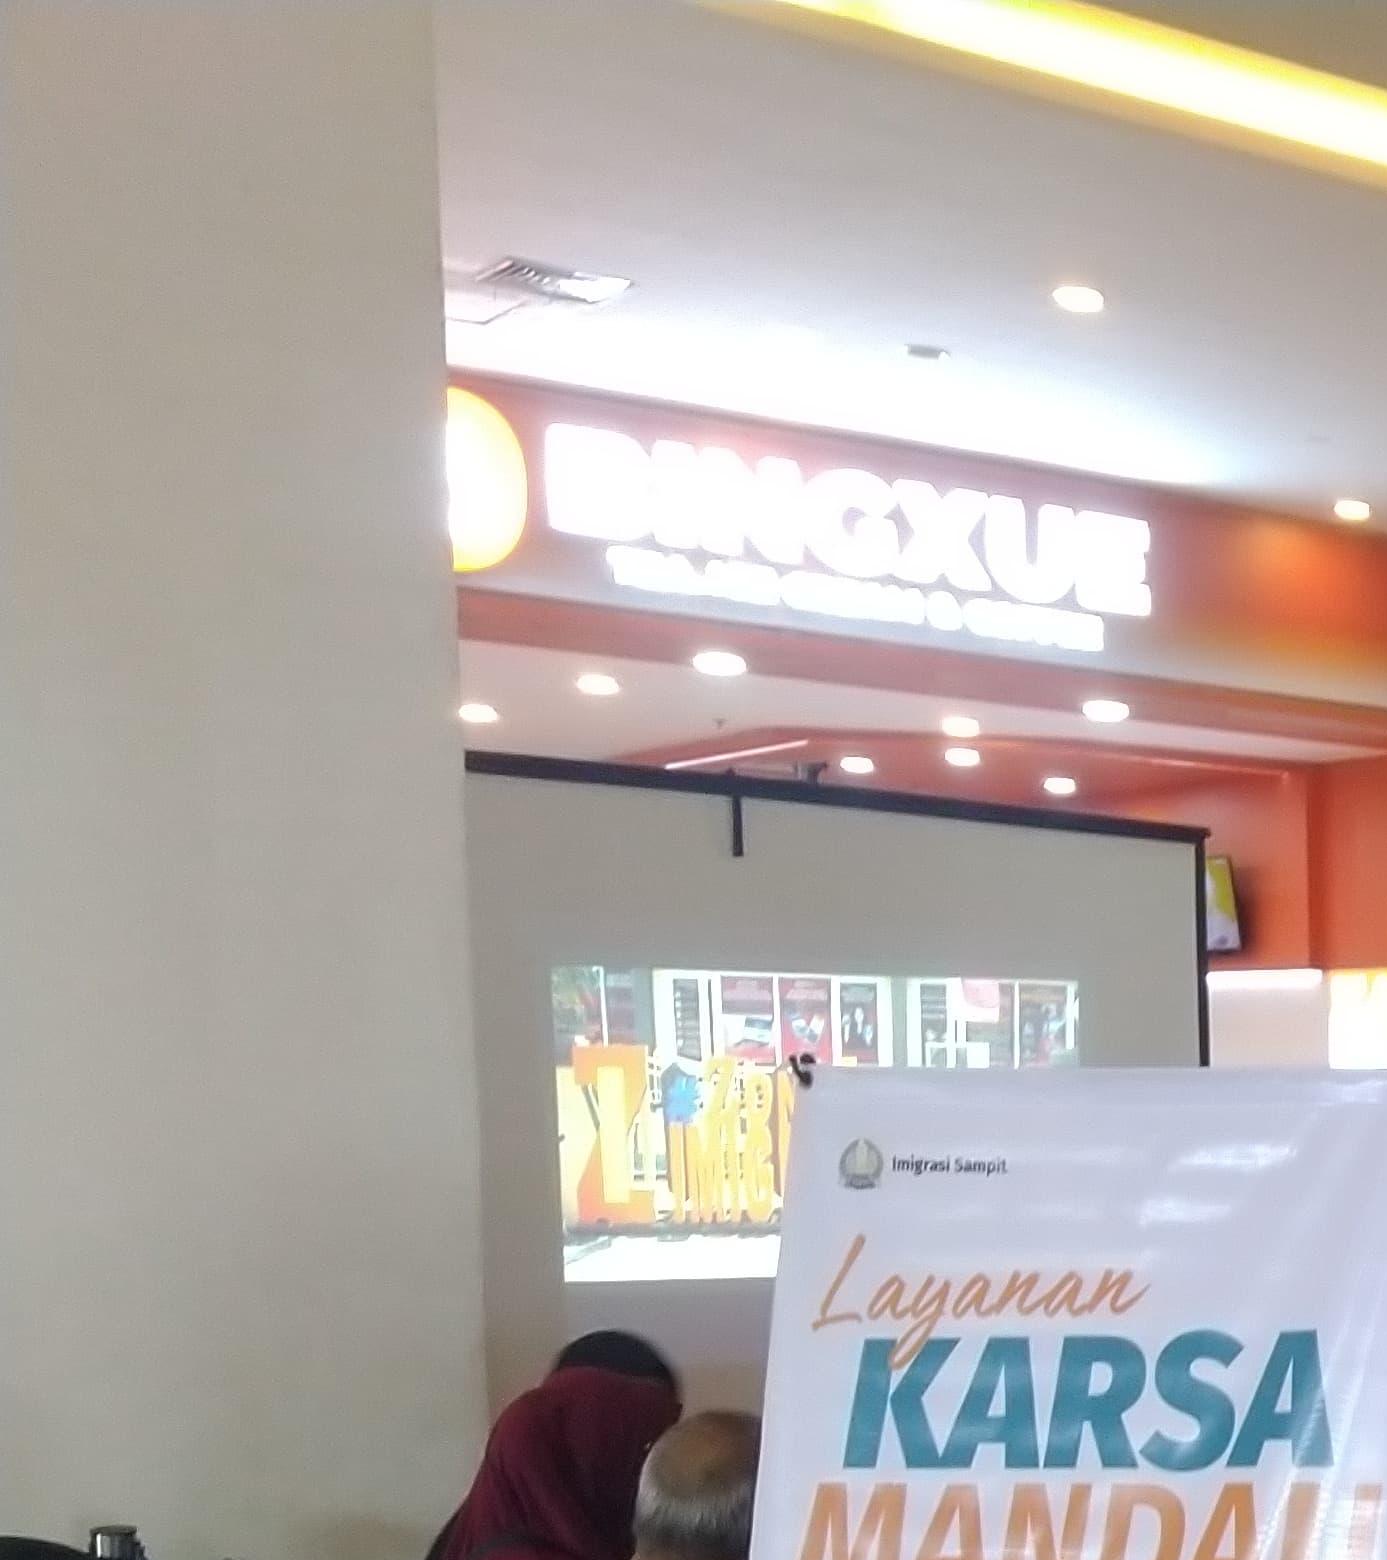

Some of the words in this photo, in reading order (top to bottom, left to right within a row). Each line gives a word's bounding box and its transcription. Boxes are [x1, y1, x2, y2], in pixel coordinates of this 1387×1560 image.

[891, 1155, 951, 1176] Imigrasi
[954, 1157, 1008, 1176] Sampit
[811, 1233, 1151, 1370] Layanan
[841, 1328, 1335, 1472] KARSA
